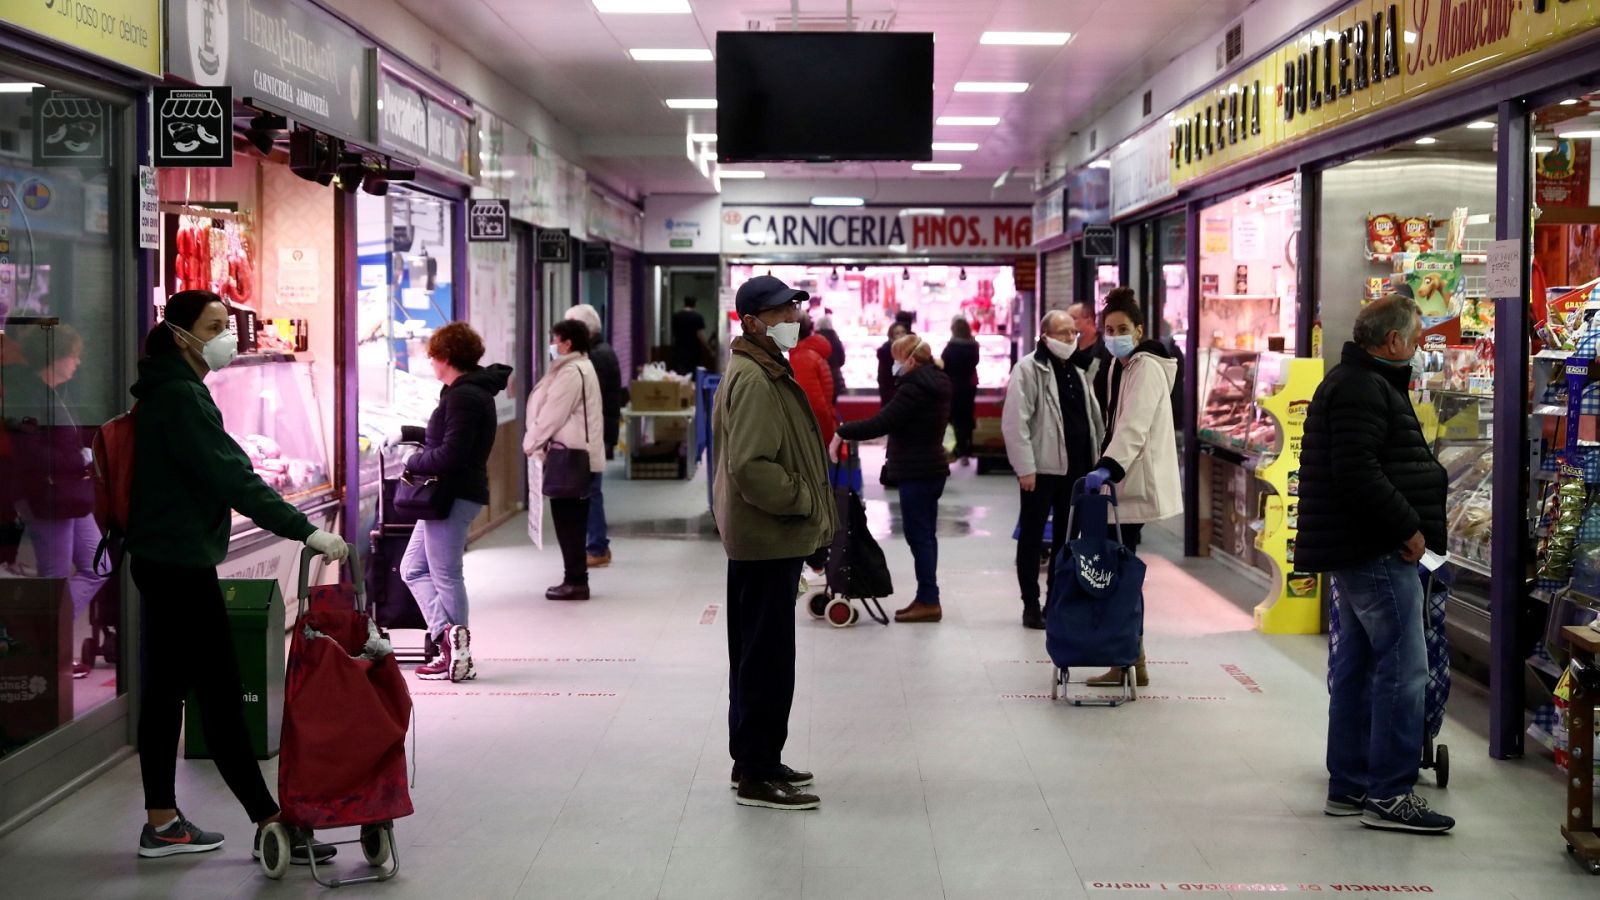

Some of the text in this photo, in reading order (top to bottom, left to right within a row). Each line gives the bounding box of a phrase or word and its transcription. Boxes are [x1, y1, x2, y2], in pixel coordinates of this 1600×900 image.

[75, 2, 99, 29] paso
[101, 12, 116, 39] por
[119, 14, 148, 48] delante
[253, 69, 330, 118] CARNICERÍA JAMONERÍA
[1175, 79, 1261, 169] POLLERIA
[1284, 4, 1400, 121] BOLLERIA
[743, 215, 906, 247] CARNICERIA
[912, 216, 987, 249] HNOS.
[994, 216, 1032, 249] MA
[1567, 367, 1587, 375] EAGLE
[1092, 881, 1151, 890] metro
[1330, 883, 1434, 893] DISTANCIA
